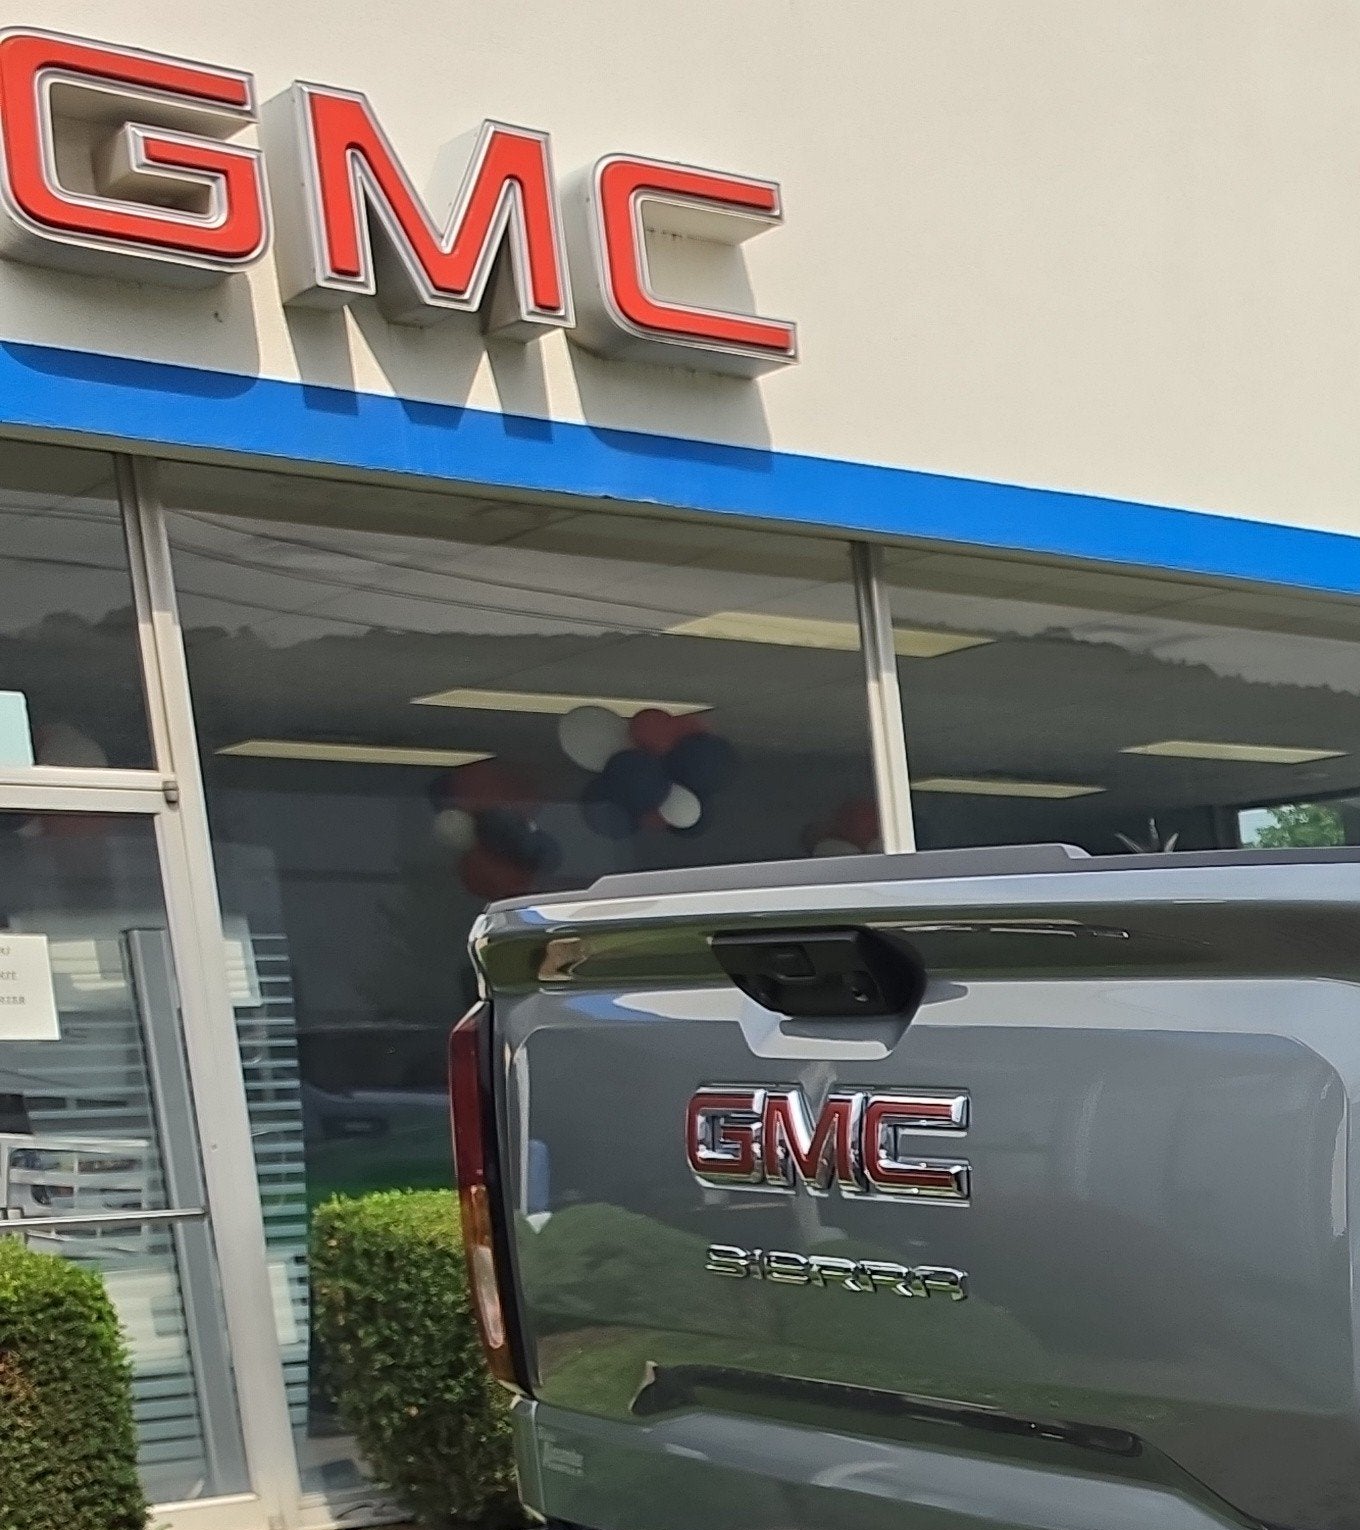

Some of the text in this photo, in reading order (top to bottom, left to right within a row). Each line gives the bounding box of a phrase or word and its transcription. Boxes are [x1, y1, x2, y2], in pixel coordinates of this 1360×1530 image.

[0, 26, 799, 366] GMC
[685, 1083, 971, 1202] GMC
[705, 1243, 969, 1301] SIERRA
